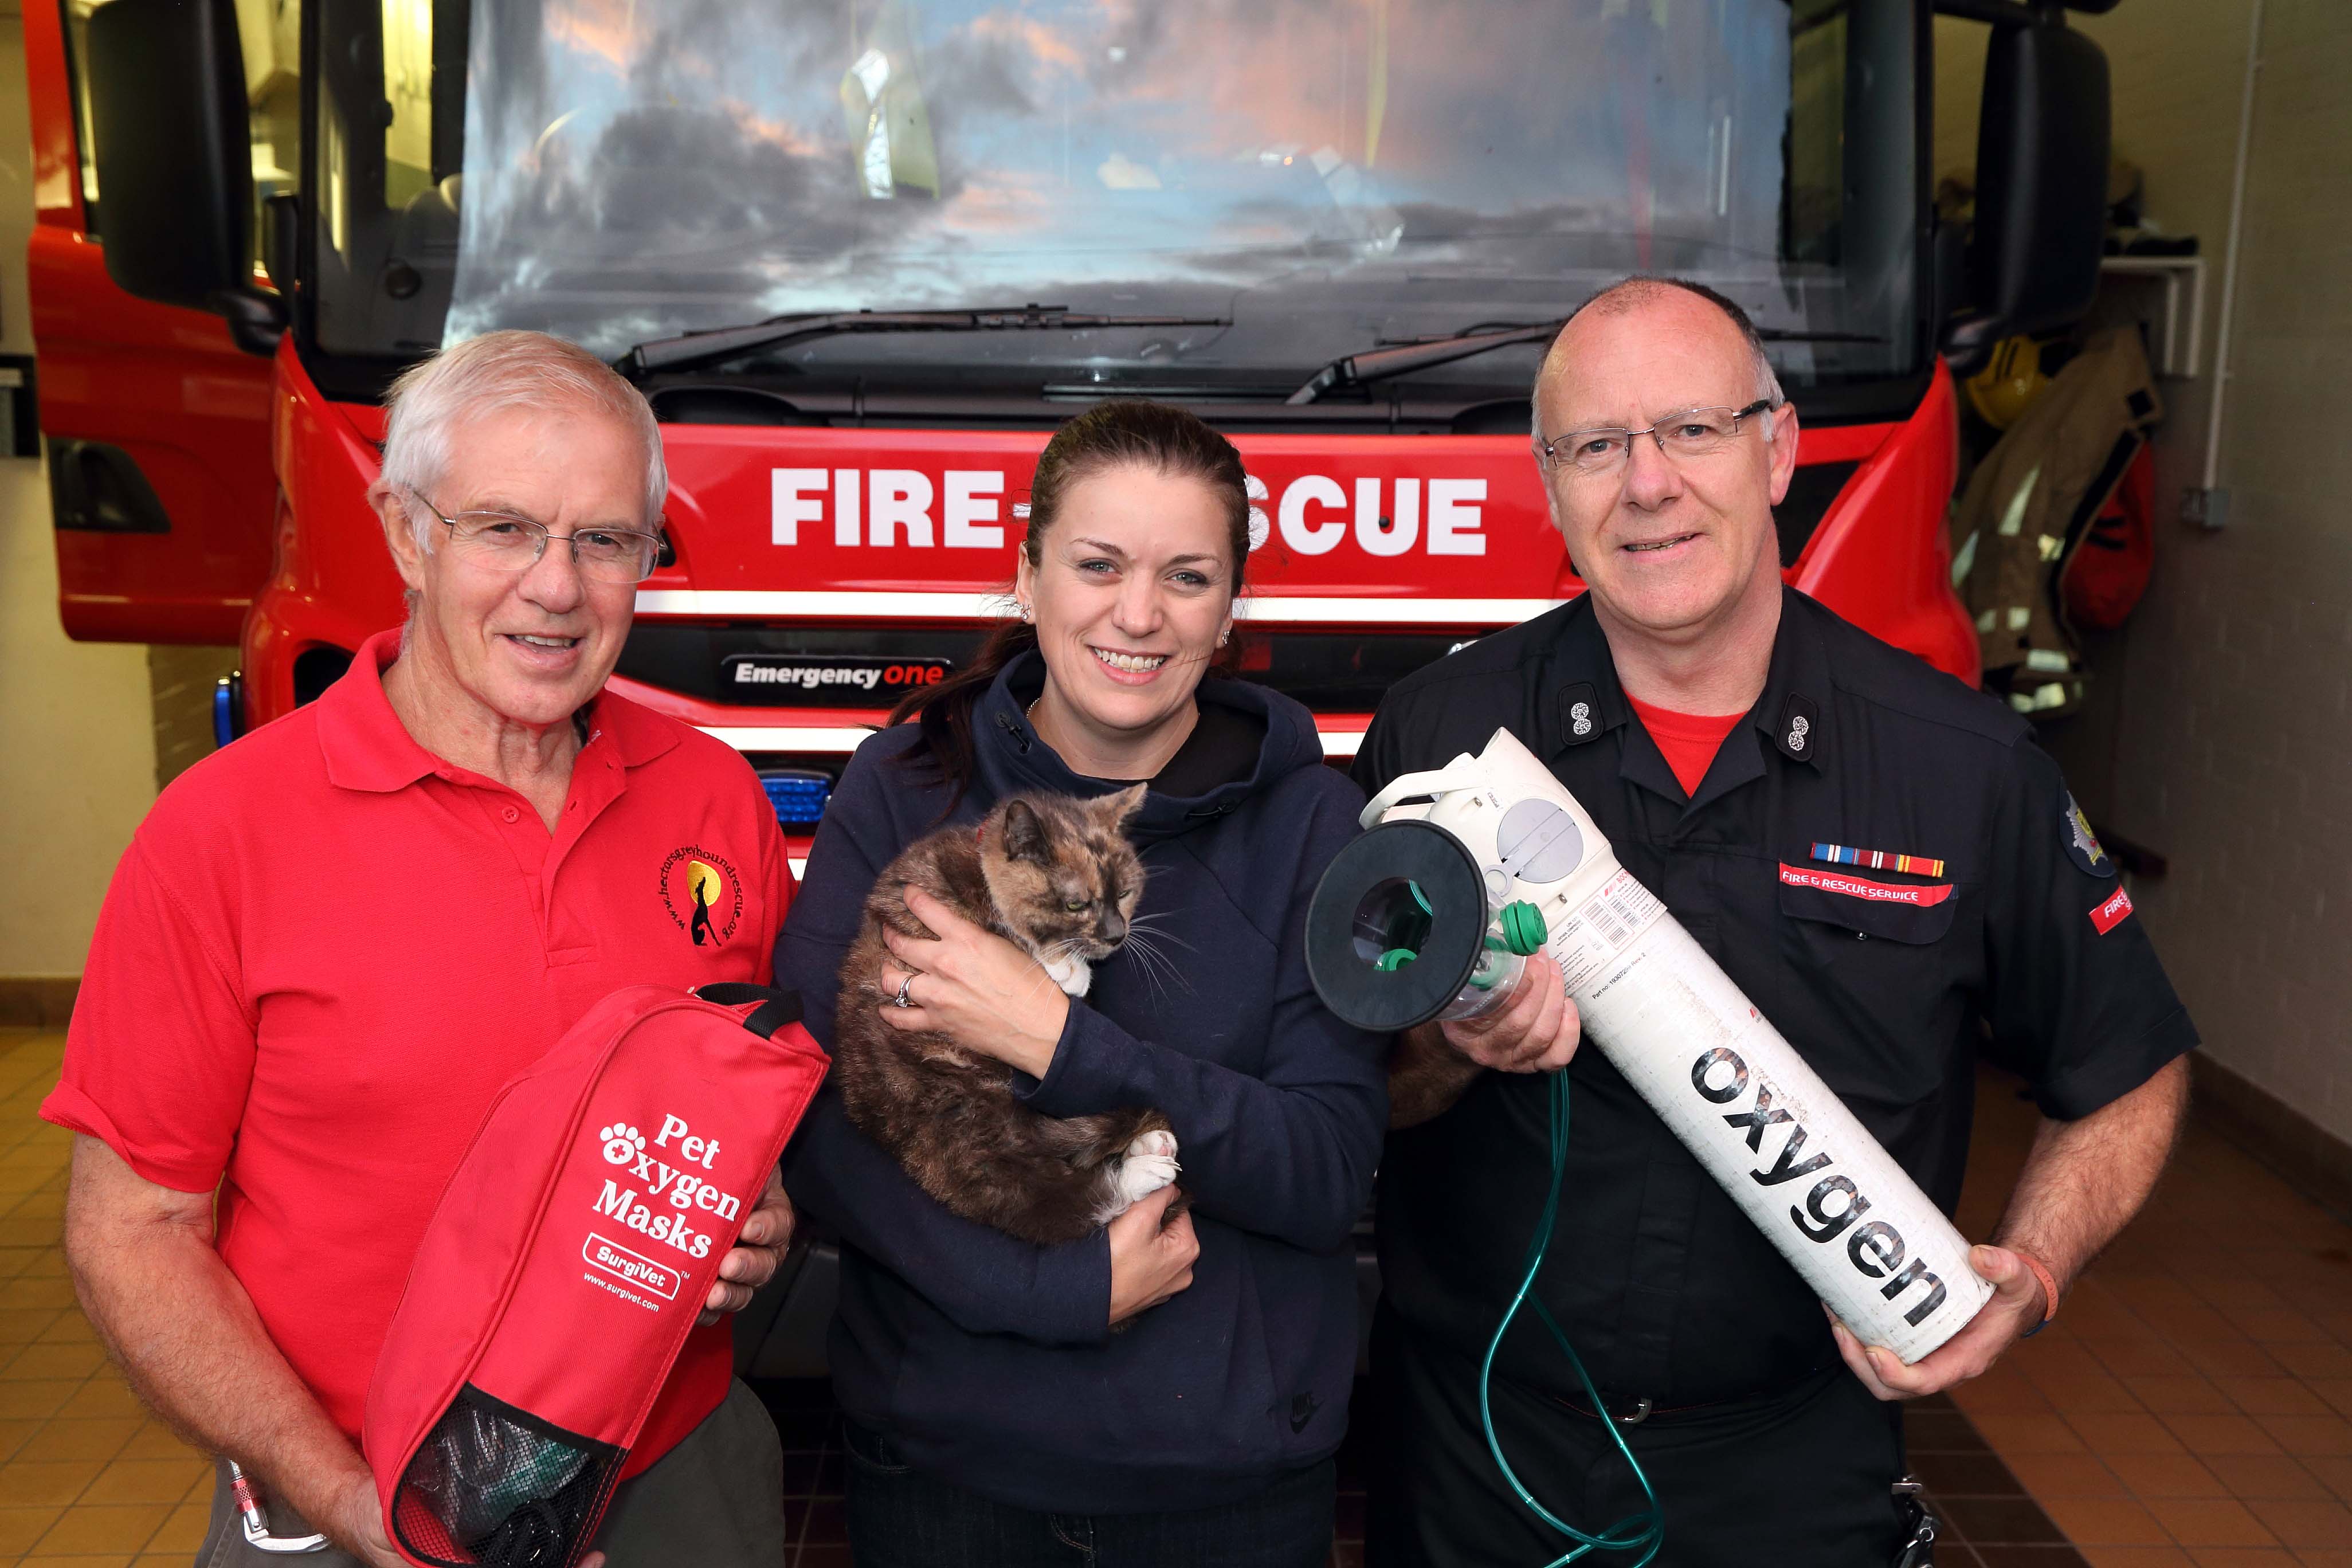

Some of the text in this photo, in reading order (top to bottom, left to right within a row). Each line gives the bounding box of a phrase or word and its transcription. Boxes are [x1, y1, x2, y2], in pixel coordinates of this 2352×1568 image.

[735, 663, 944, 689] Emergency one
[1782, 871, 1919, 901] FIRE & RESCUE SERVICE
[2104, 895, 2125, 918] FIRE
[1592, 990, 1603, 999] Part
[654, 1114, 720, 1169] Pet
[602, 1137, 741, 1221] Oxygen
[1691, 1047, 1947, 1327] oxygen
[592, 1179, 712, 1259] Masks
[596, 1246, 666, 1287] SurgiVet
[583, 1273, 660, 1312] www.surgivet.com
